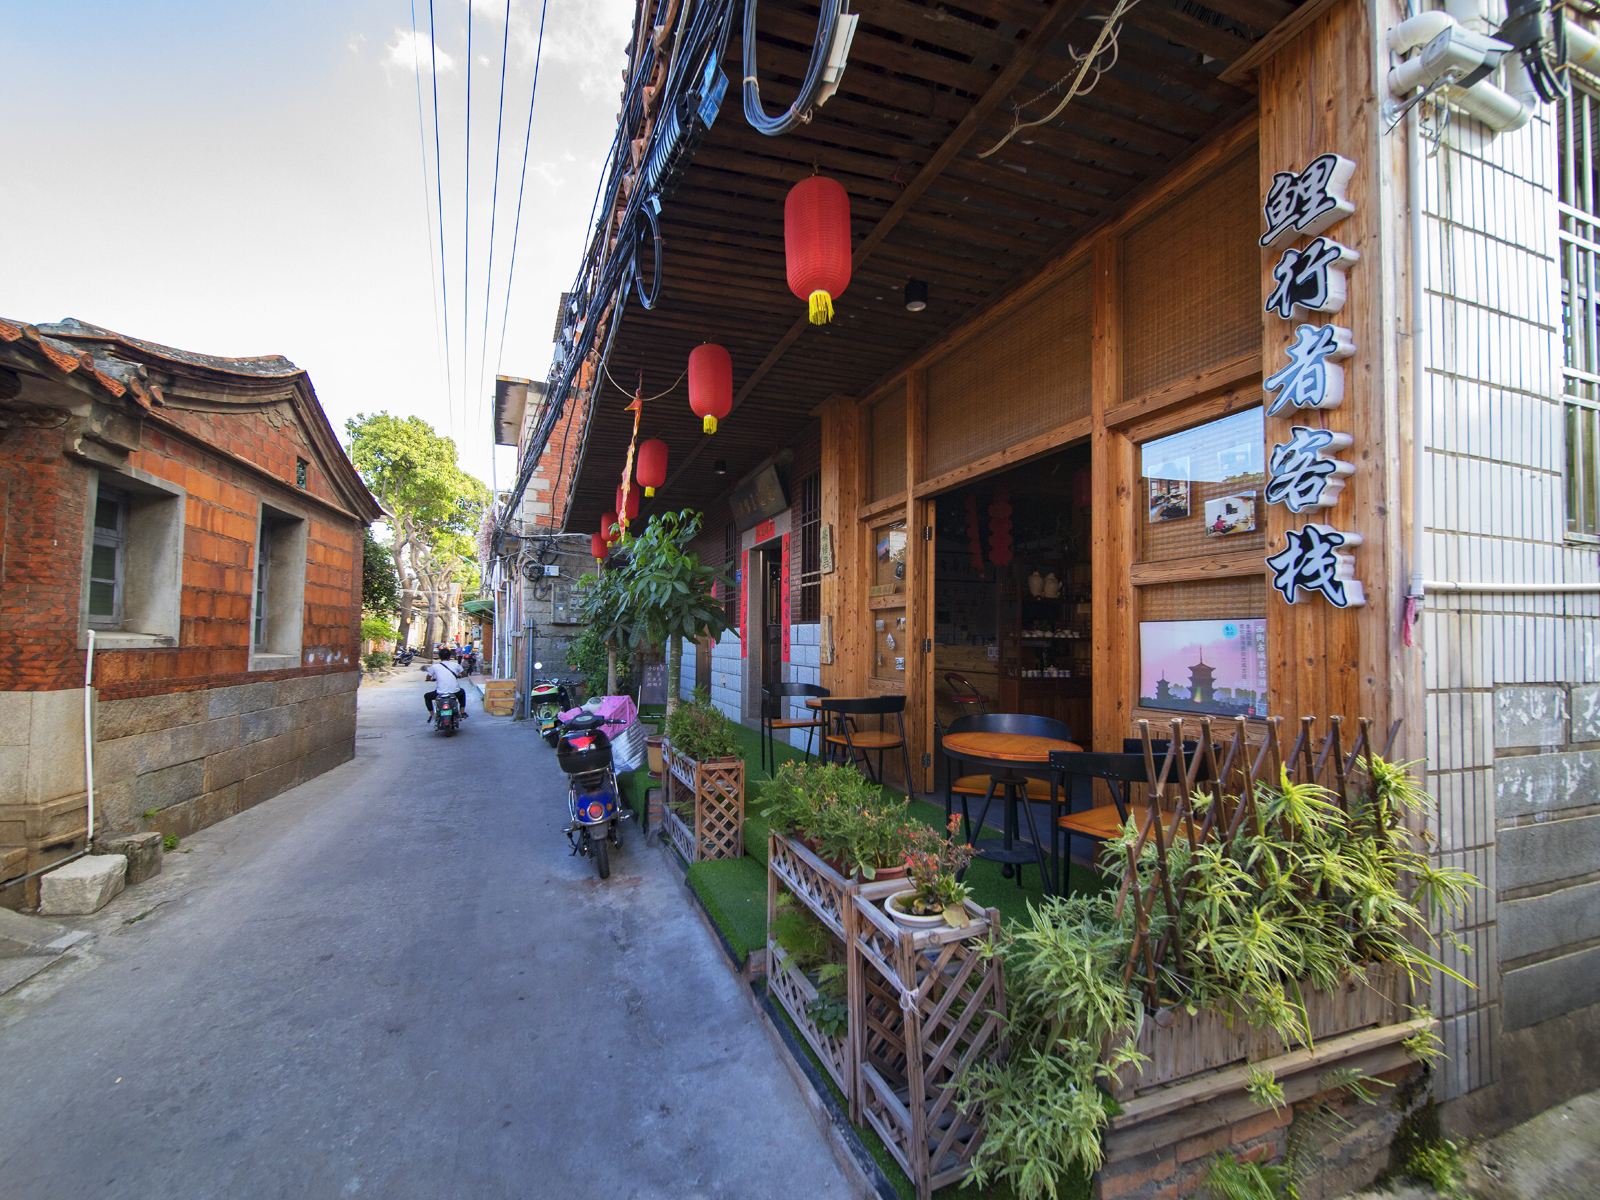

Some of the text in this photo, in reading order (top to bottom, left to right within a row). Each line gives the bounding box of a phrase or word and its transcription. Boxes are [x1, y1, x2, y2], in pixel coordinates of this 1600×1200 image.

[1259, 153, 1350, 608] 鲤行者客栈
